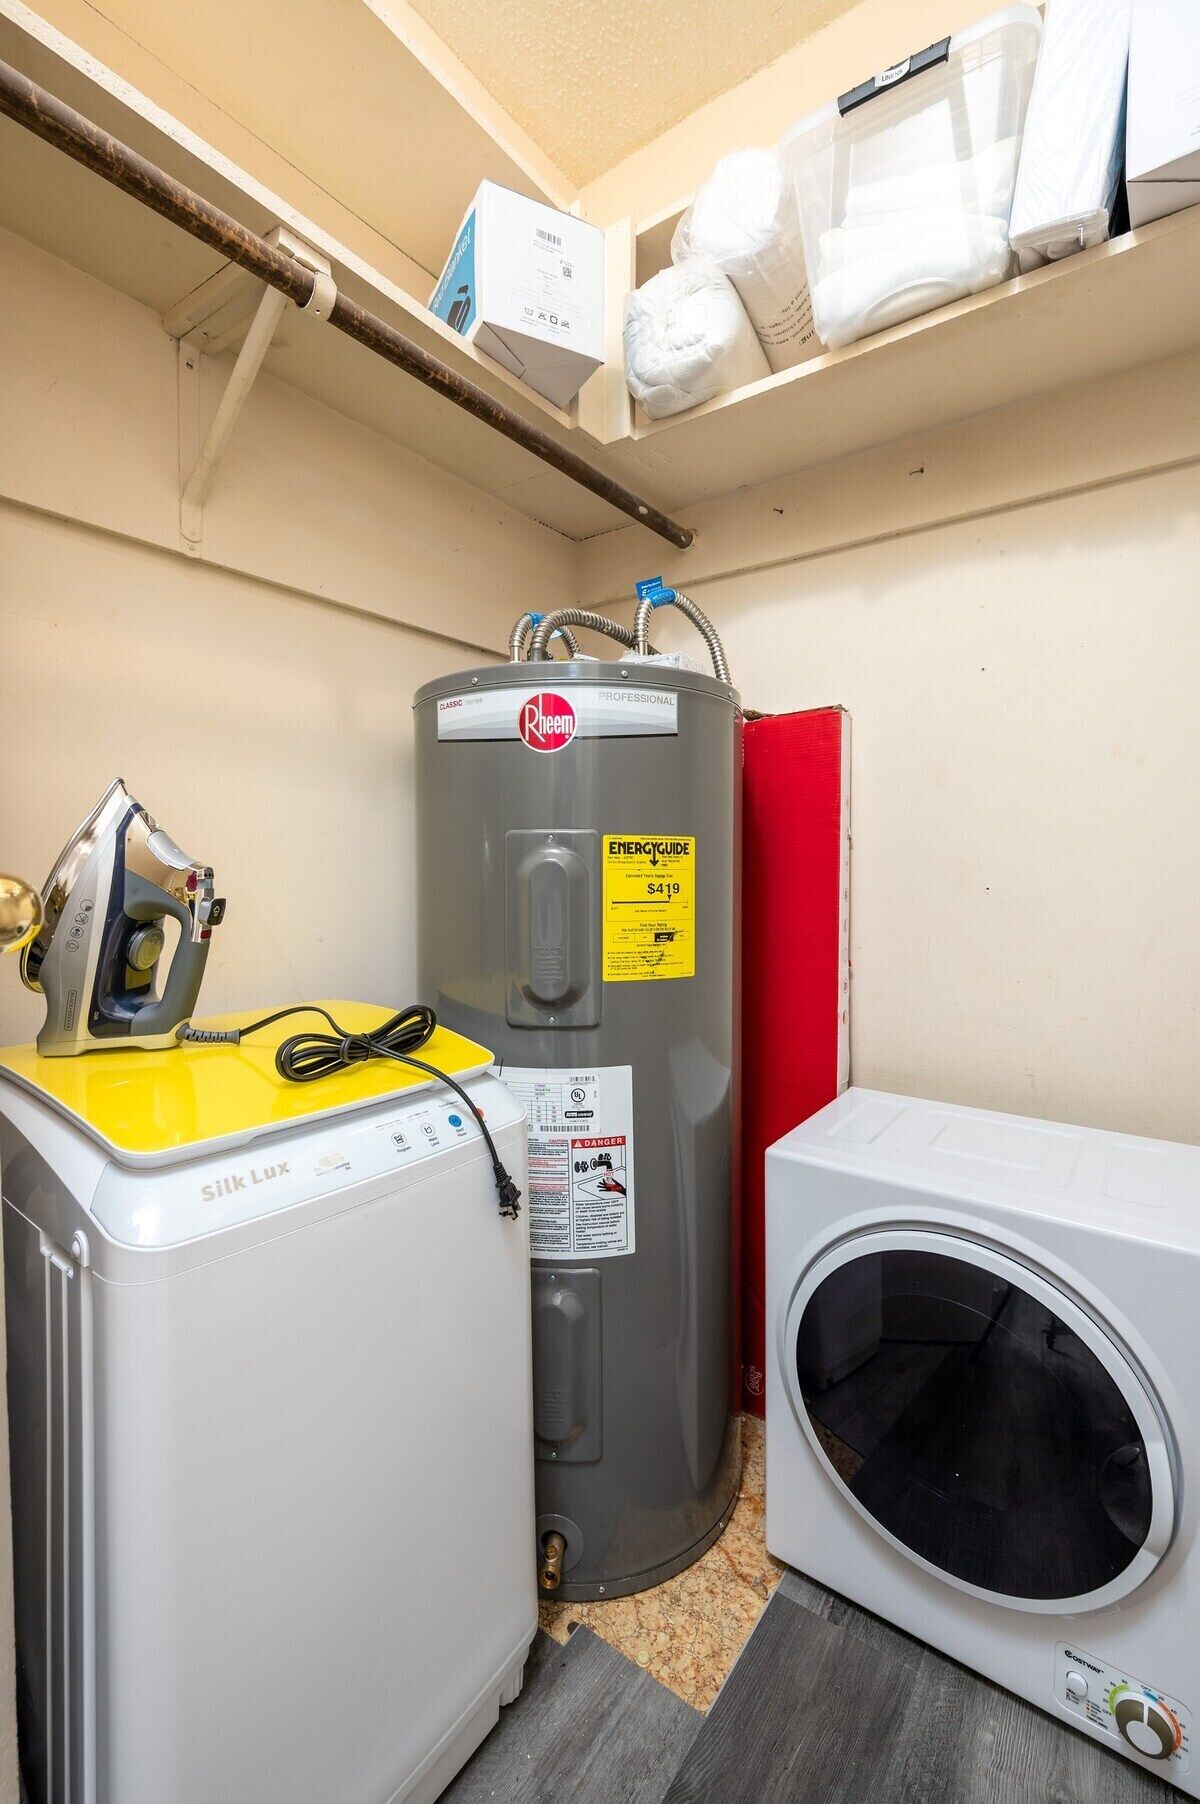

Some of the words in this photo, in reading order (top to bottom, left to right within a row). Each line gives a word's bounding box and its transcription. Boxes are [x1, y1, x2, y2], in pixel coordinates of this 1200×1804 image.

[439, 699, 463, 711] CLASSIC
[465, 696, 484, 706] series
[598, 691, 676, 706] PROFESSIONAL
[524, 693, 574, 743] Rheem
[647, 883, 680, 895] $419
[584, 1137, 623, 1147] DANGER
[201, 1175, 247, 1202] Silk
[250, 1161, 290, 1185] Lux
[1064, 1650, 1102, 1674] COSTWAY
